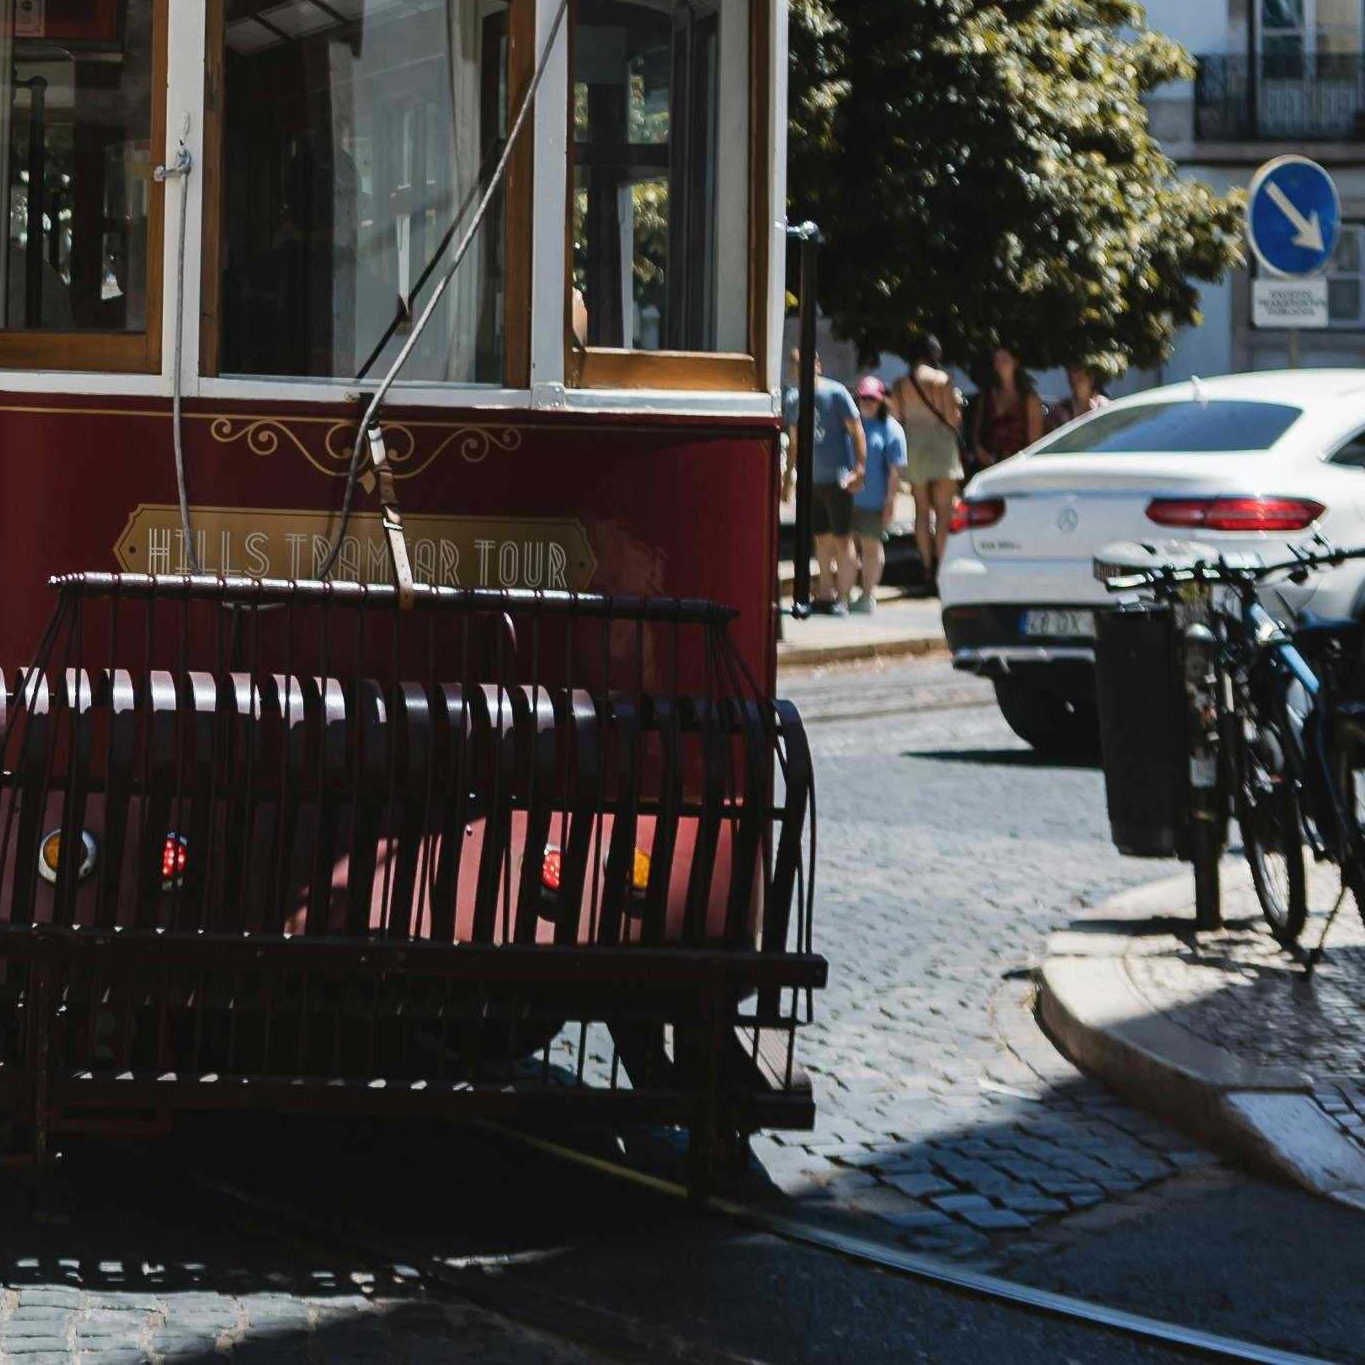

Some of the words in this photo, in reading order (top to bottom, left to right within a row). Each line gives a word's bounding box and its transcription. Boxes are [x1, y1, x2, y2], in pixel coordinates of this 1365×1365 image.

[147, 527, 270, 579] HILLS
[284, 533, 460, 586] TRAMAR
[474, 539, 568, 588] TOUR
